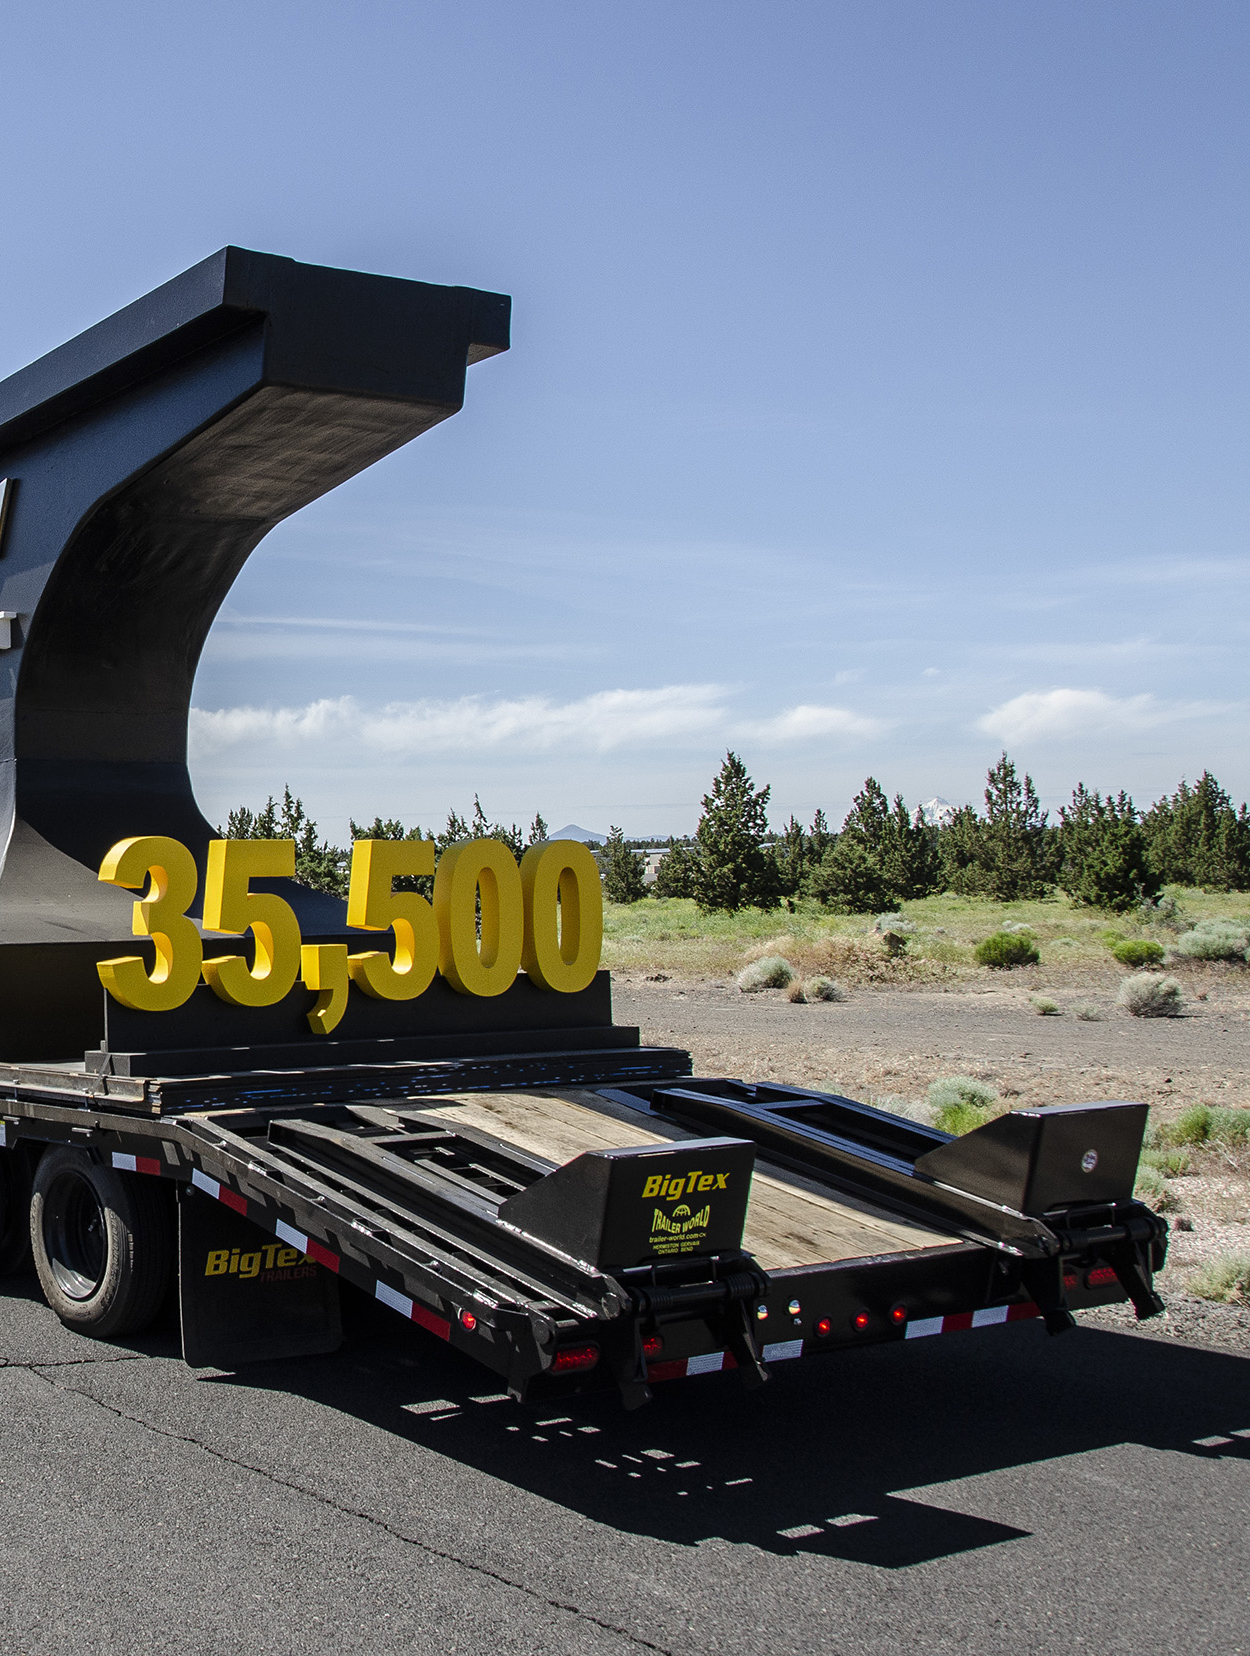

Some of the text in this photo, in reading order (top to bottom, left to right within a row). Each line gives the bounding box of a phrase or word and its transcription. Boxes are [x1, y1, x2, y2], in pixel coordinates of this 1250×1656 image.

[96, 836, 603, 1034] 35,500
[652, 1205, 710, 1233] TRAILER WORLD
[261, 1266, 317, 1282] TRAILERS
